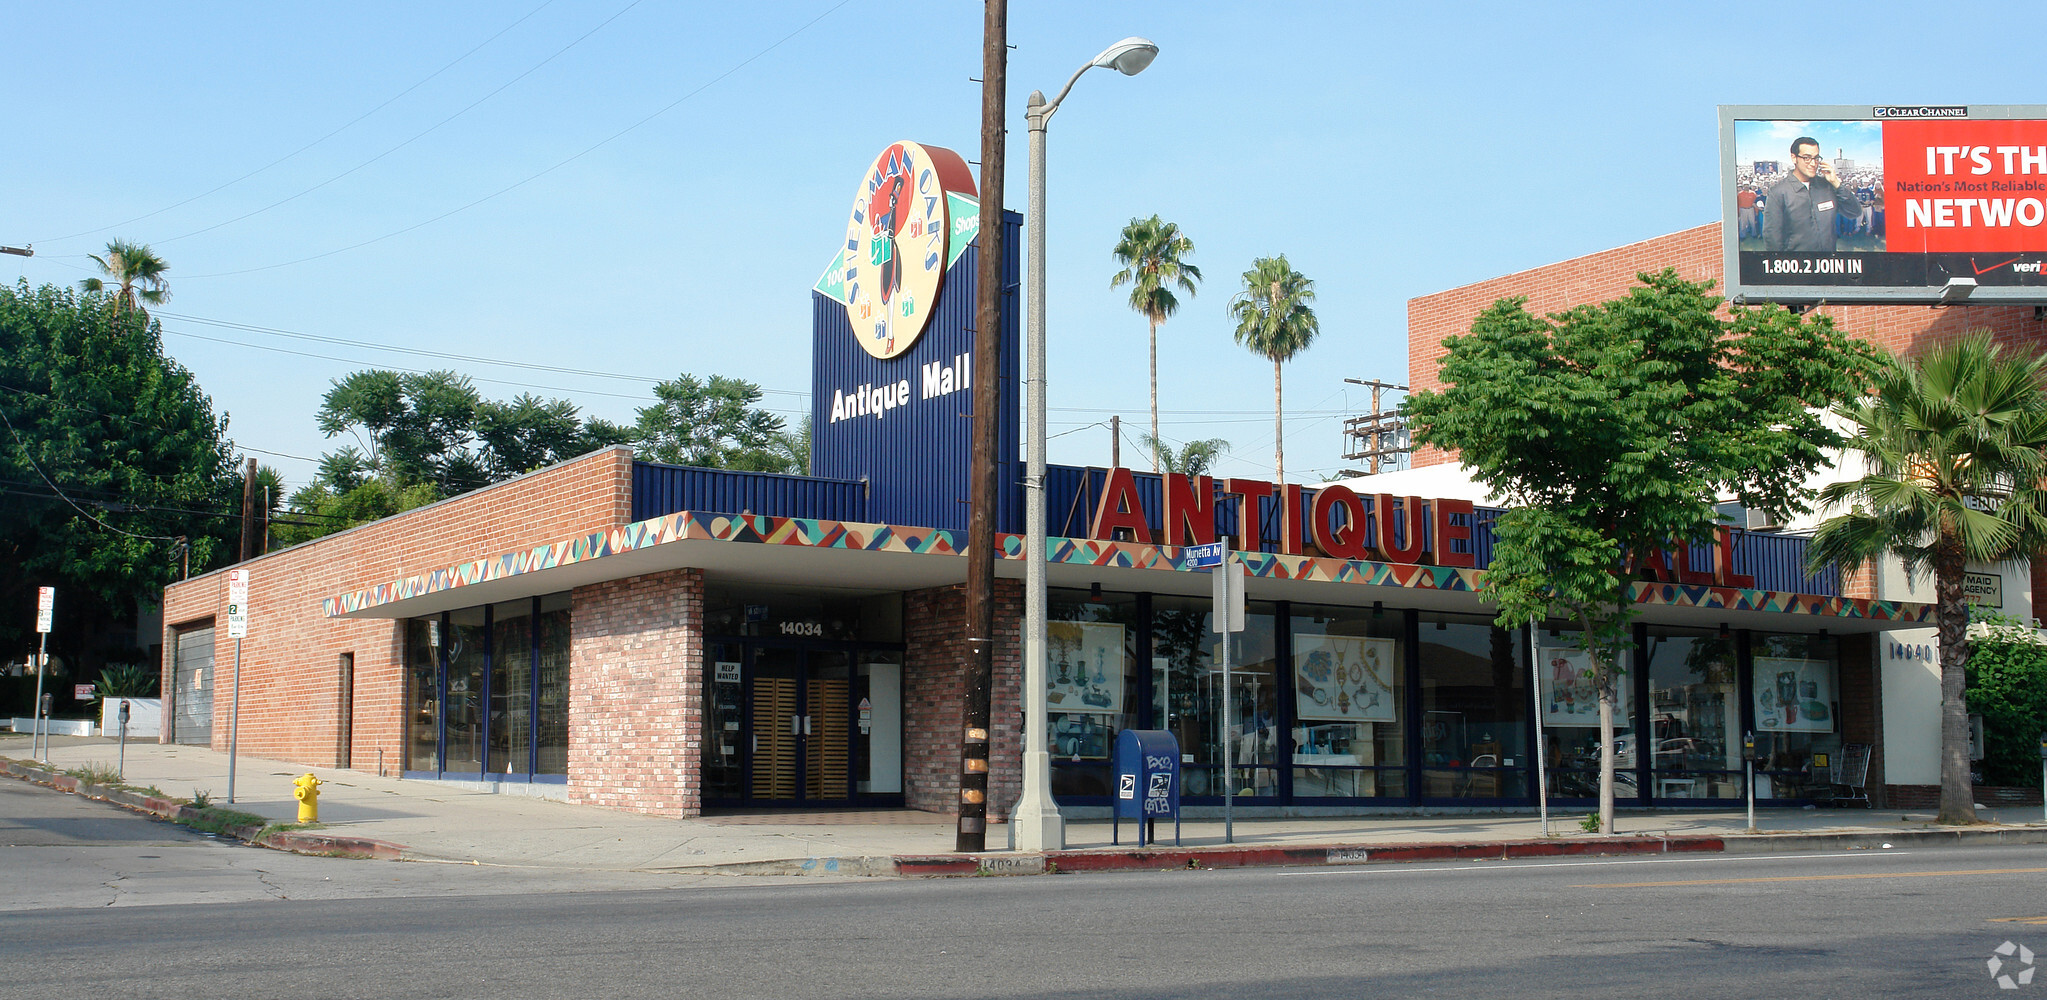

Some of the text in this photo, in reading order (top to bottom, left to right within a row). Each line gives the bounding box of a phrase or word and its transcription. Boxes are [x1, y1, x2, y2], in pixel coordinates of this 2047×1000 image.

[1926, 145, 1993, 176] IT'S
[1896, 180, 2046, 192] Nation's Most Reliable
[918, 168, 940, 273] OAKS
[1762, 258, 1863, 274] 1.800.2 JOIN IN
[826, 266, 844, 288] 100
[830, 352, 970, 424] Antique Mall
[1091, 466, 1475, 567] ANTIQUE
[1212, 545, 1221, 556] Av
[1186, 559, 1198, 567] 4200
[1967, 576, 1992, 585] MAID
[1964, 585, 1997, 595] AGENCY
[230, 606, 236, 614] 2
[779, 621, 822, 637] 14034
[1889, 641, 1931, 661] 14040
[721, 664, 735, 672] HELP
[717, 673, 739, 681] WANTED
